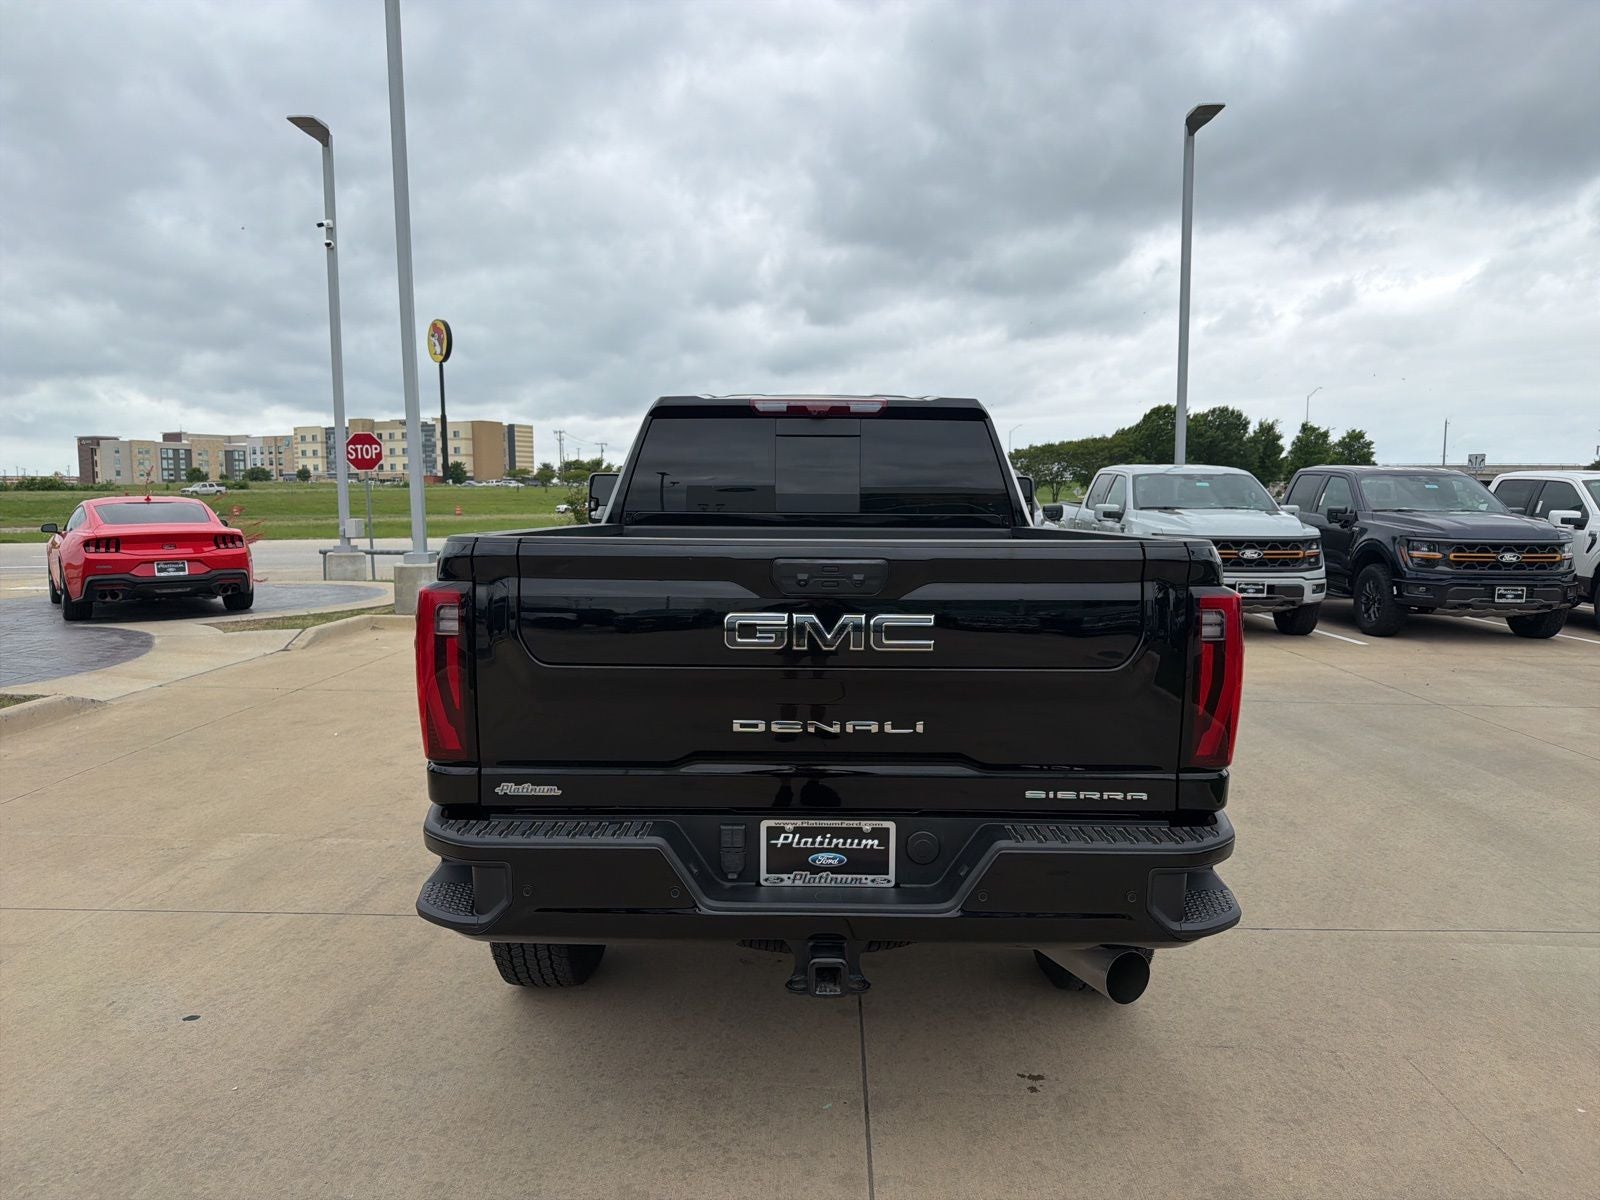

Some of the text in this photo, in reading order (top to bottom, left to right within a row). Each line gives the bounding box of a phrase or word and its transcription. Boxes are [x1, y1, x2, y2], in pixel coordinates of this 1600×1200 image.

[347, 444, 380, 459] STOP
[724, 612, 935, 651] GMC
[732, 719, 924, 734] DENALI
[494, 783, 562, 795] Platinum
[1025, 790, 1148, 801] SIERRA
[769, 833, 886, 849] Platinum
[815, 854, 839, 865] Ford
[790, 872, 868, 885] Platinum
